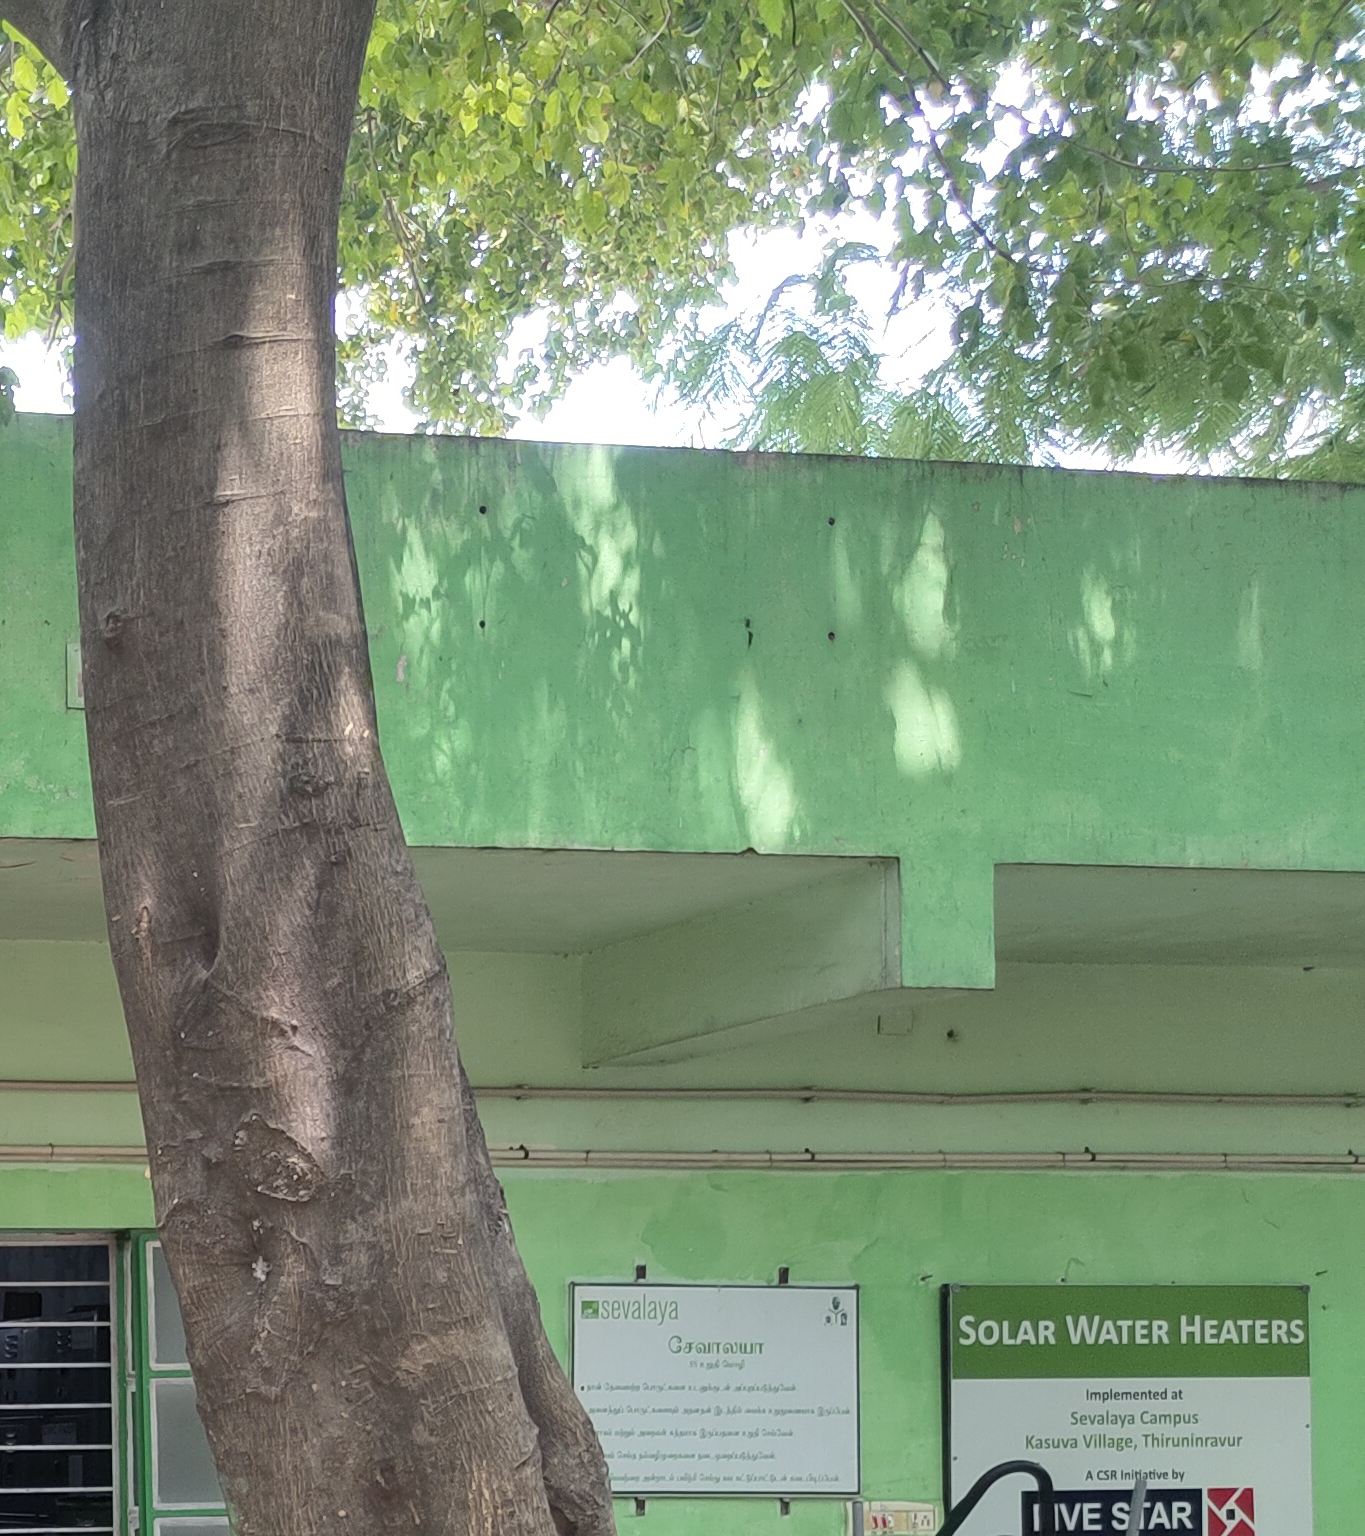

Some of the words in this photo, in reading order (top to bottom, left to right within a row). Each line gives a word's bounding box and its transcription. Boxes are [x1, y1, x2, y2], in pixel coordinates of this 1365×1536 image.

[600, 1293, 679, 1326] sevalaya
[958, 1314, 1056, 1346] SOLAR
[1065, 1314, 1170, 1345] WATER
[1179, 1314, 1305, 1345] HEATERS
[667, 1335, 765, 1355] சேவாலயா
[1085, 1387, 1168, 1404] Implemented
[1170, 1388, 1184, 1401] at
[1070, 1410, 1136, 1429] Sevalaya
[1139, 1410, 1199, 1428] Campus
[1024, 1434, 1078, 1450] Kasuva
[1082, 1433, 1138, 1452] Village,
[1141, 1432, 1244, 1450] Thiruninravur
[1085, 1470, 1094, 1481] A
[1096, 1469, 1118, 1481] CSR
[1120, 1468, 1169, 1481] Initiative
[1171, 1468, 1186, 1483] by
